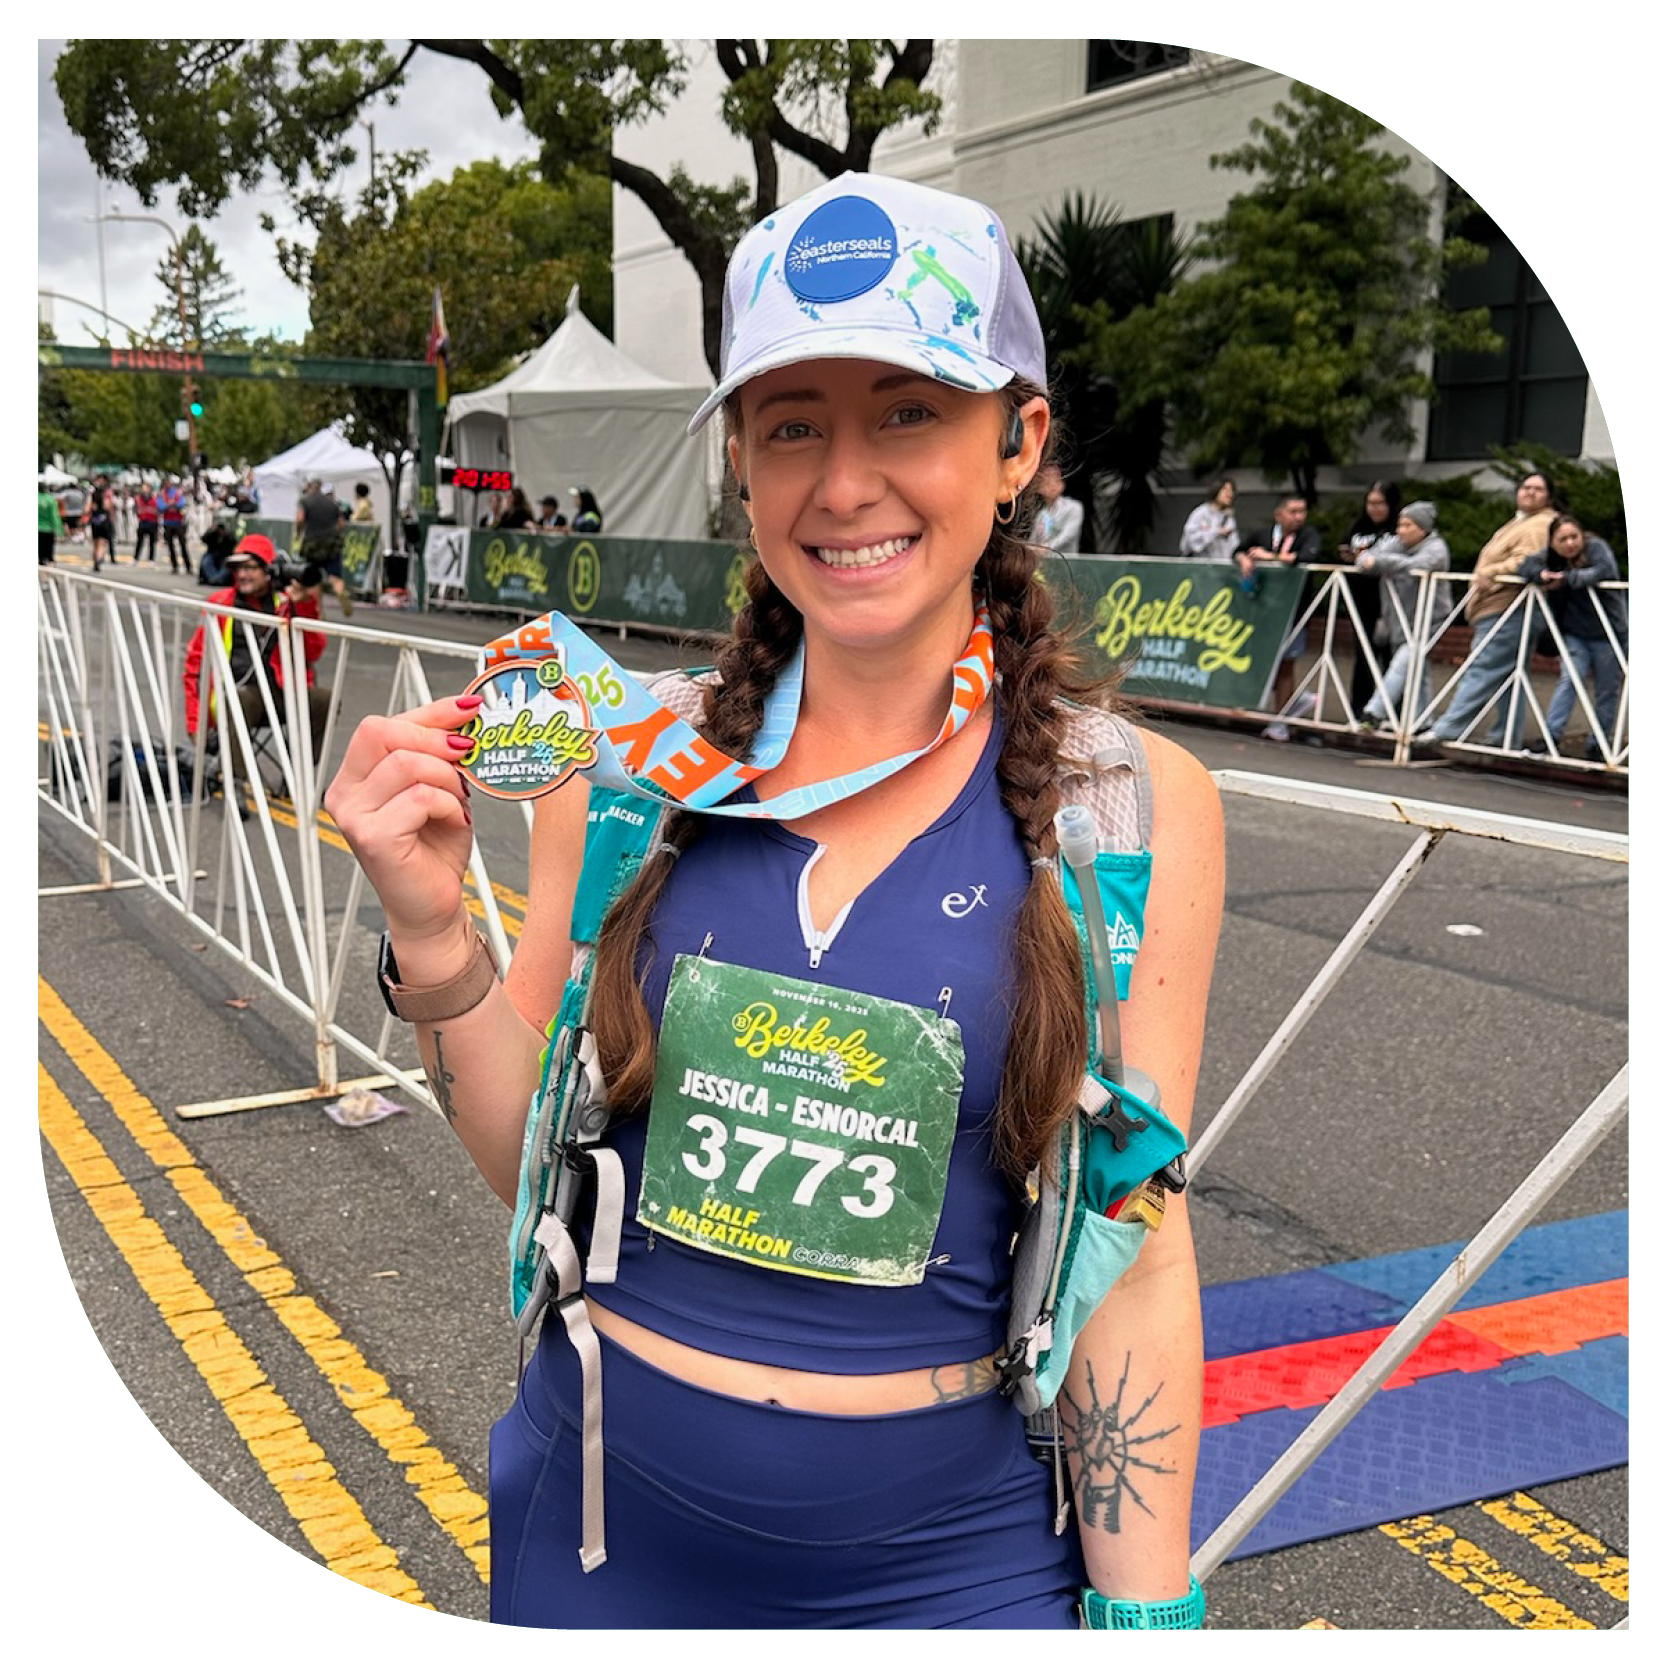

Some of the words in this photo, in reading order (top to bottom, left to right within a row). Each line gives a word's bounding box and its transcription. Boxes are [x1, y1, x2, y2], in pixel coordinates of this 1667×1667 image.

[800, 236, 892, 259] easterseals
[817, 253, 852, 264] Northern
[852, 251, 891, 259] California
[111, 349, 205, 371] FINISH
[1096, 575, 1255, 673] Berkeley
[1142, 639, 1186, 658] HALF
[477, 764, 561, 778] MARATHON
[484, 750, 526, 764] HALF
[772, 988, 826, 1006] NOVEMBER
[844, 1004, 869, 1016] 2025
[734, 1002, 887, 1087] Berkeley
[779, 1050, 820, 1067] HALF
[762, 1061, 851, 1094] MARATHON
[679, 1068, 769, 1117] JESSICA
[791, 1096, 919, 1148] ESNORCAL
[682, 1113, 898, 1219] 3773
[700, 1198, 761, 1229] HALF
[666, 1206, 793, 1259] MARATHON
